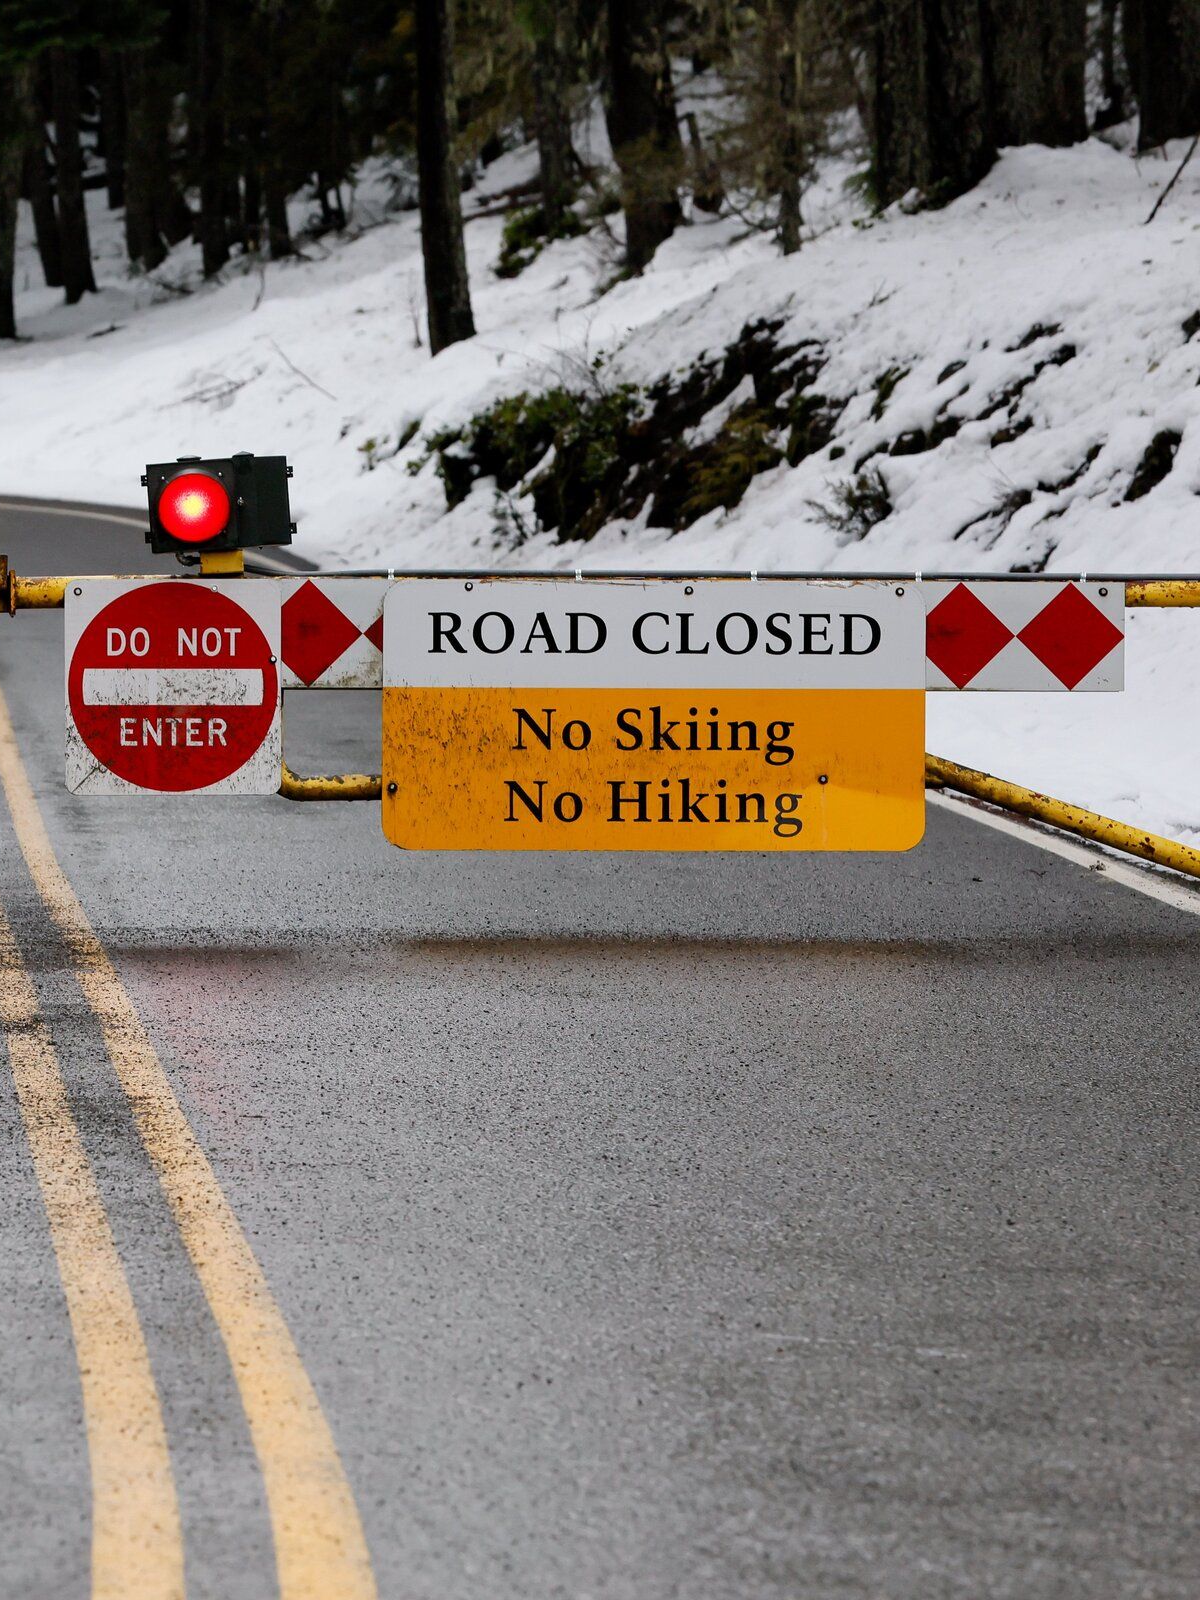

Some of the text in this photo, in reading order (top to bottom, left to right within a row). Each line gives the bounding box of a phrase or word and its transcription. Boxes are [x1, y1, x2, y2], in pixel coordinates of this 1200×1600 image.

[106, 627, 242, 657] DO NOT
[428, 611, 882, 656] ROAD CLOSED
[120, 717, 228, 747] ENTER
[512, 706, 795, 766] No Skiing
[503, 778, 803, 838] No Hiking
